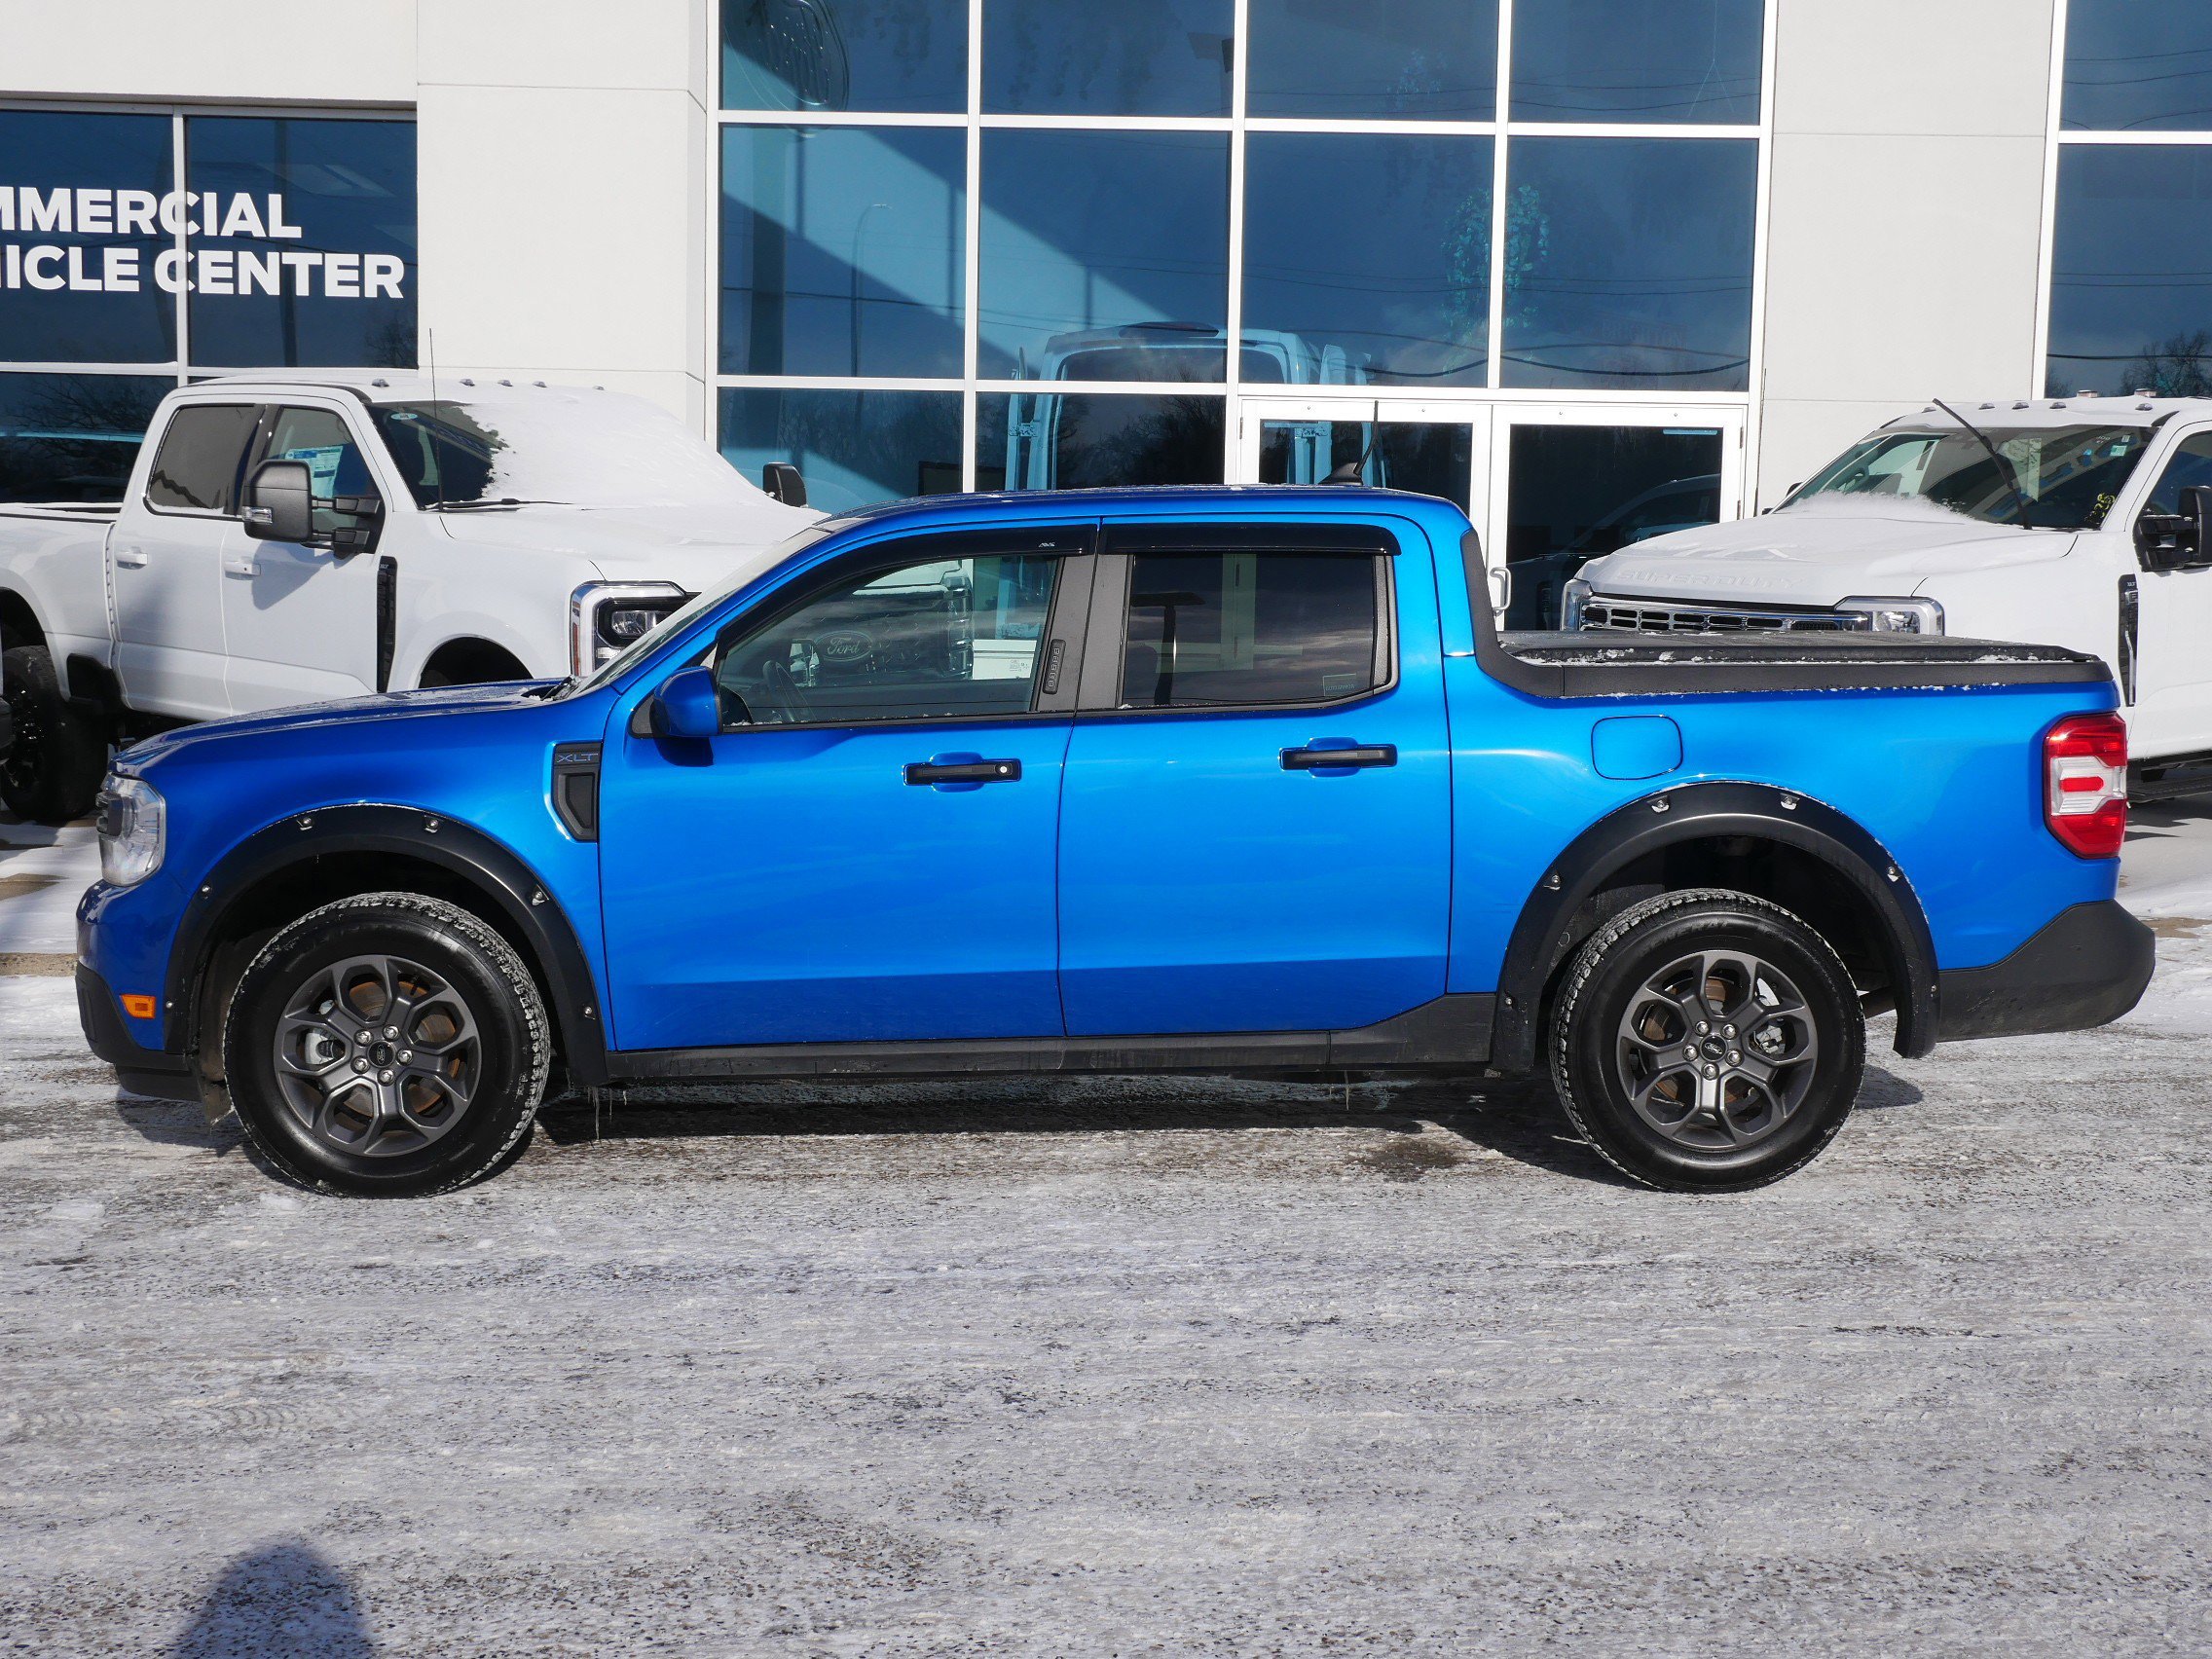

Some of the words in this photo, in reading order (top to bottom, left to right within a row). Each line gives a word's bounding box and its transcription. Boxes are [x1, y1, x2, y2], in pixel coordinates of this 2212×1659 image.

[0, 186, 302, 239] MERCIAL
[0, 244, 139, 292] ICLE
[154, 248, 405, 299] CENTER
[828, 637, 861, 655] Ford
[557, 753, 599, 763] XLT
